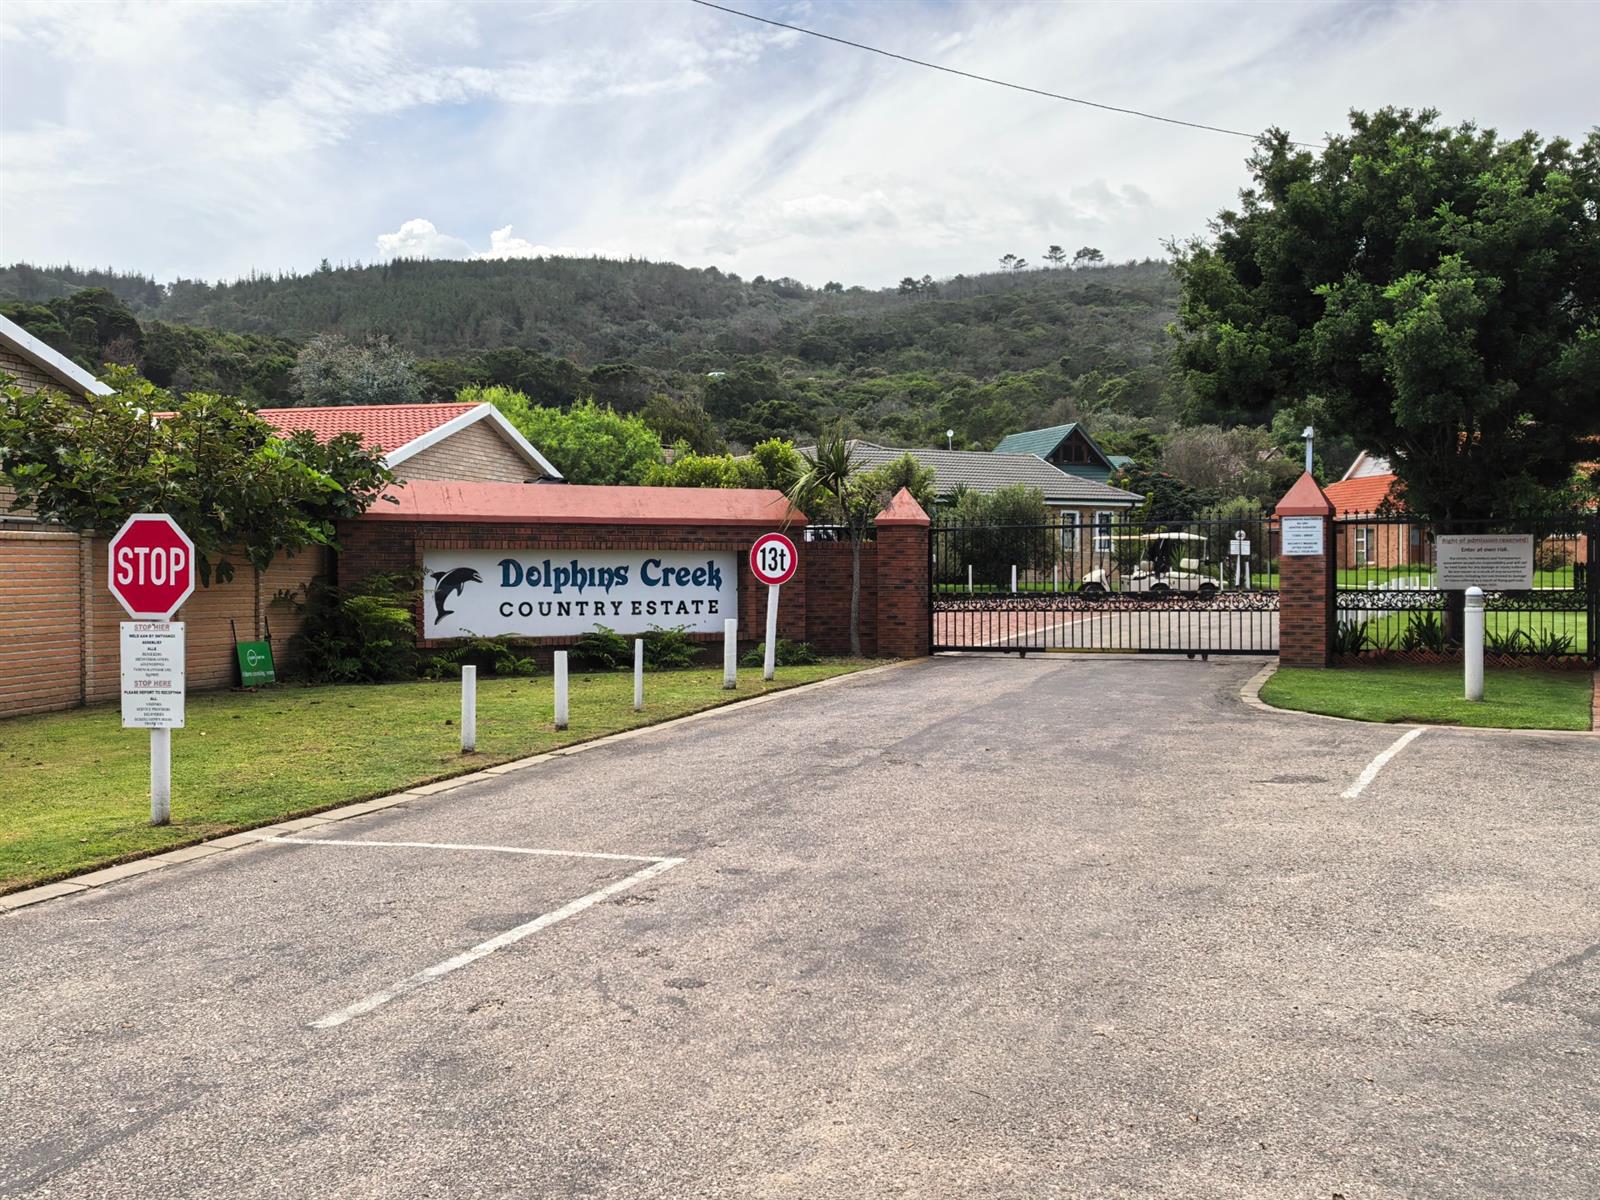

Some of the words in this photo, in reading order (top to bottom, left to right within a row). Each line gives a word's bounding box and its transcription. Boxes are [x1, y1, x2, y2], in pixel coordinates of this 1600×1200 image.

[117, 546, 186, 586] STOP
[760, 547, 787, 572] 13t
[497, 558, 629, 595] Dolphins
[640, 558, 723, 592] Creek
[499, 601, 623, 617] COUNTRY
[631, 600, 719, 616] ESTATE
[134, 623, 152, 631] STOP
[134, 680, 152, 688] STOP
[153, 680, 172, 688] HERE
